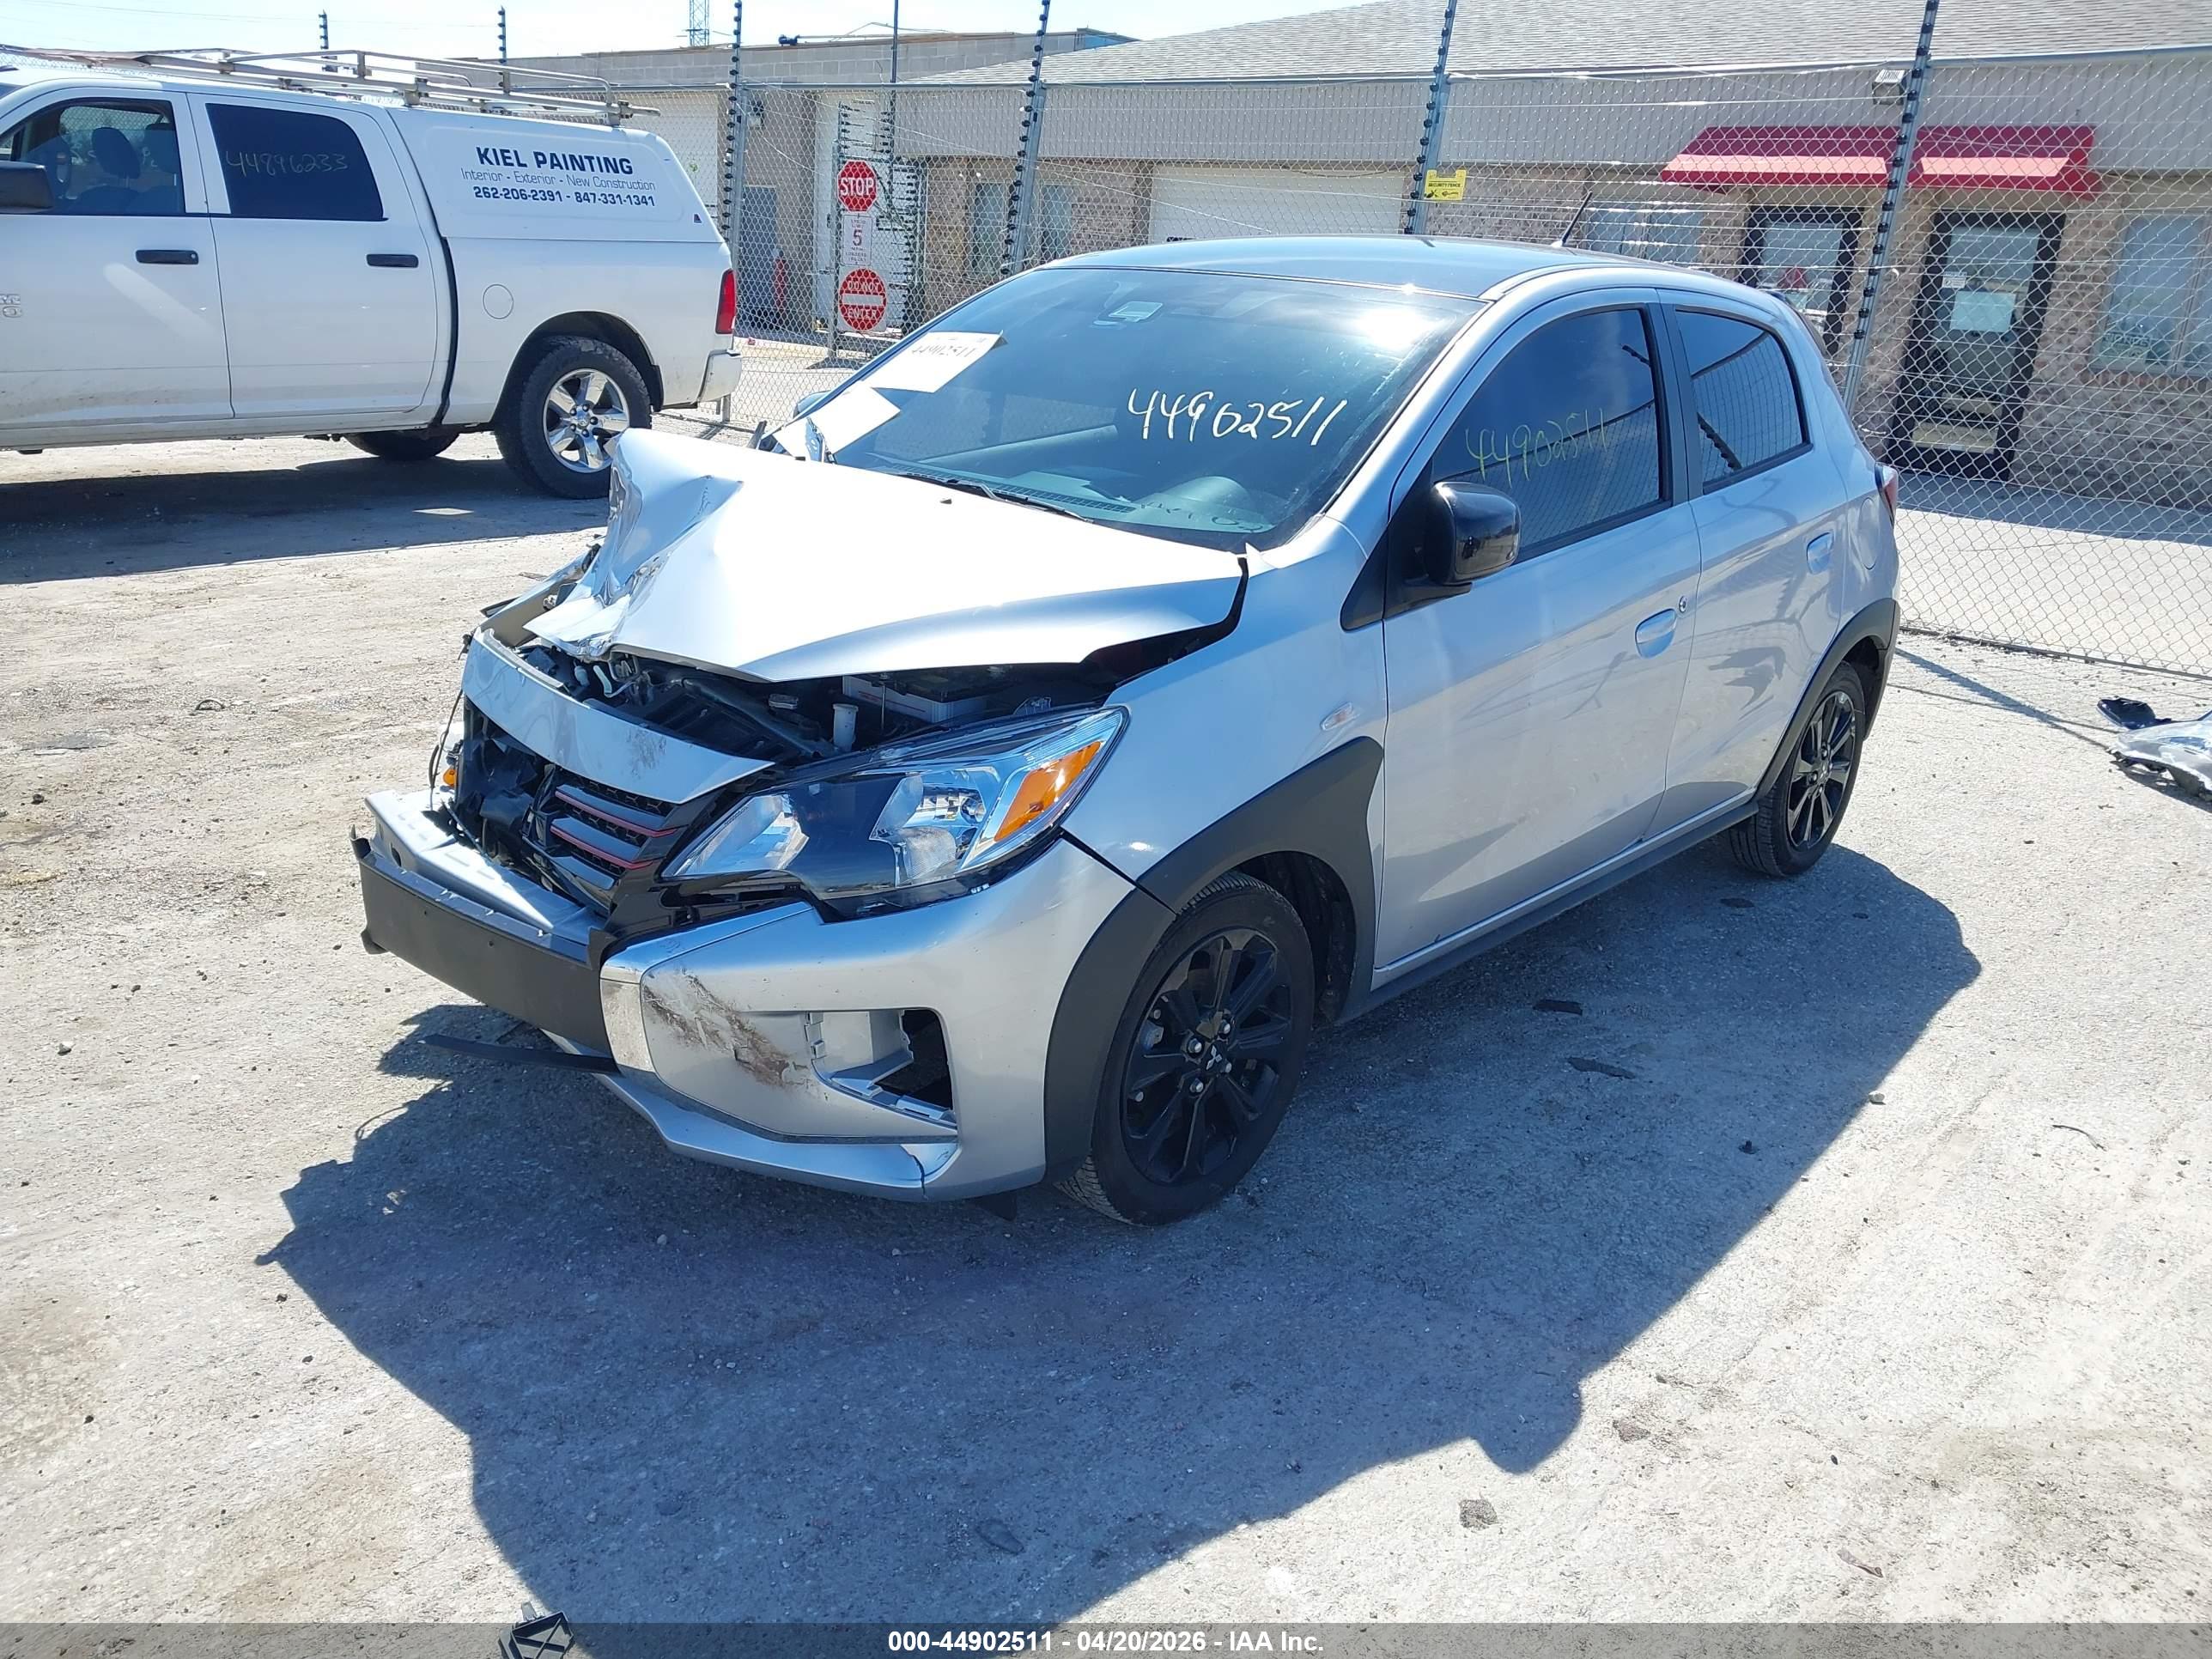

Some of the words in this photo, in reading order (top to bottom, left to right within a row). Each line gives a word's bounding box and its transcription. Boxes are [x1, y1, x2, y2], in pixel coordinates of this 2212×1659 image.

[476, 146, 527, 168] KIEL
[532, 151, 634, 175] PAINTING
[461, 167, 503, 182] Interior
[515, 171, 556, 185] Exterior
[567, 174, 590, 187] New
[593, 177, 656, 191] Construction
[840, 177, 874, 197] STOP
[473, 186, 563, 203] 262-206-2391
[575, 191, 655, 207] 847-331-1341
[853, 228, 862, 246] 5
[848, 280, 860, 290] DO
[860, 282, 878, 291] NOT
[847, 308, 877, 319] ENTER
[1465, 408, 1607, 489] 44902511
